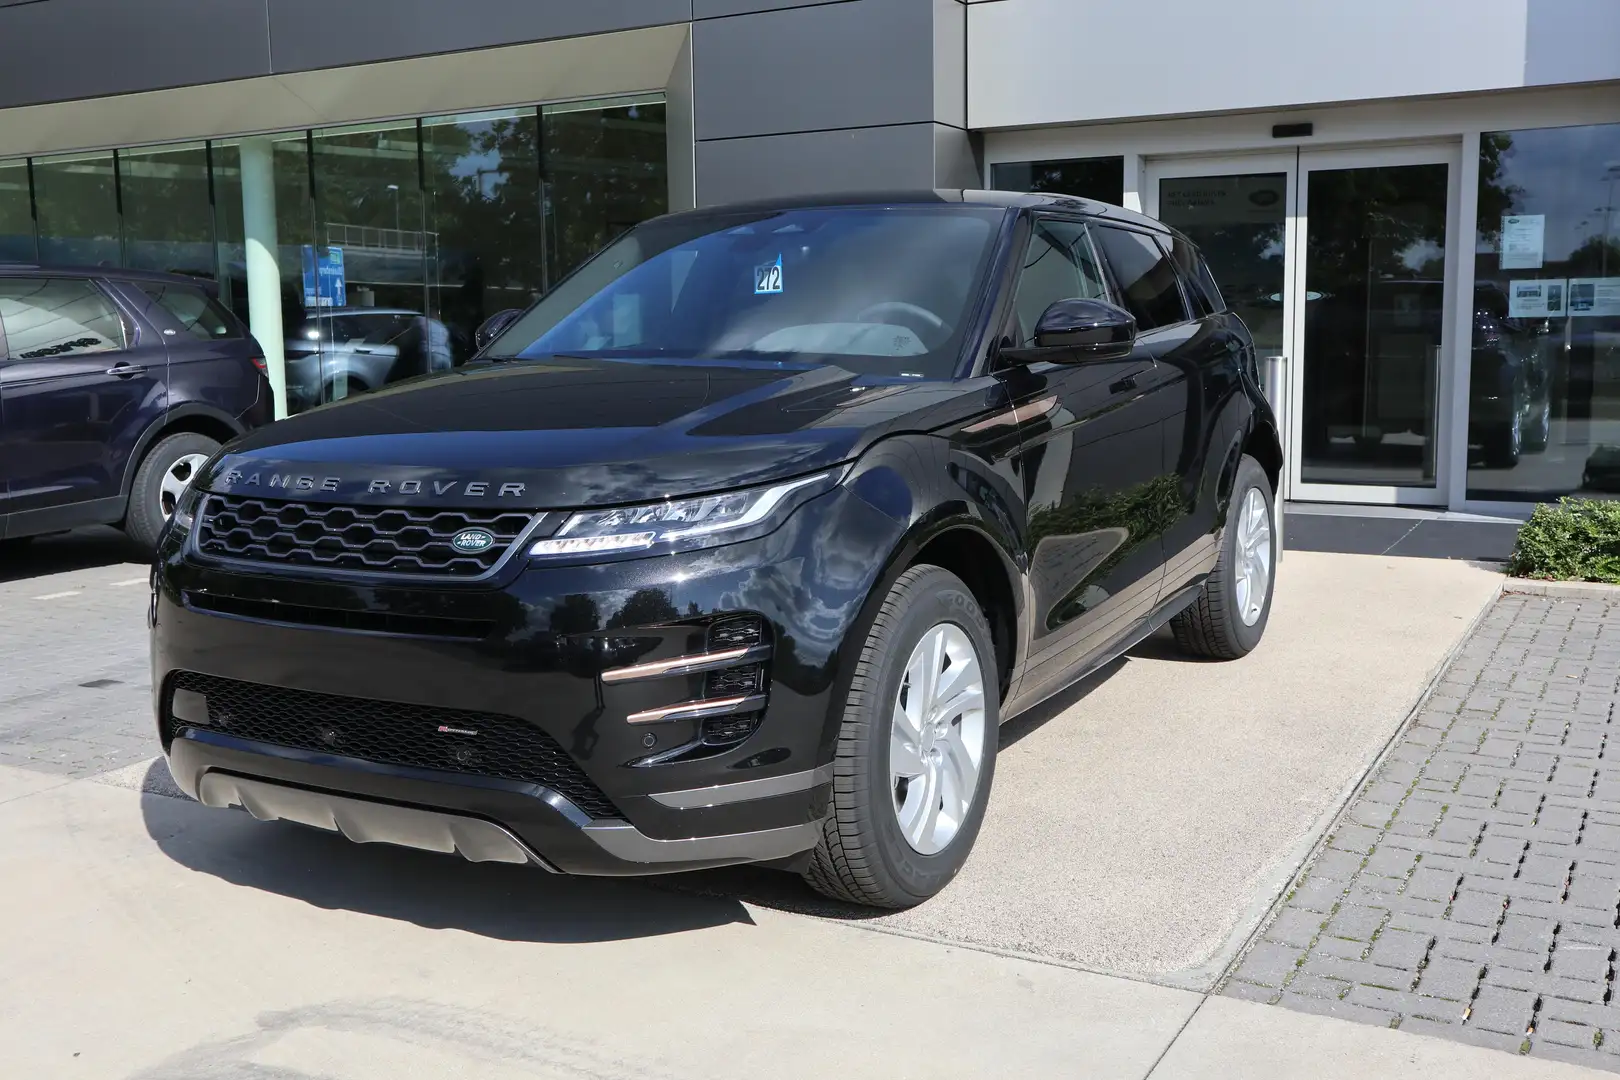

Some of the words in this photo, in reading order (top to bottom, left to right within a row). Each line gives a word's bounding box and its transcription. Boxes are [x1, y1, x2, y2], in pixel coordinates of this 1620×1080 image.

[756, 266, 780, 290] 272
[224, 470, 341, 492] RANGE
[367, 479, 526, 497] ROVER
